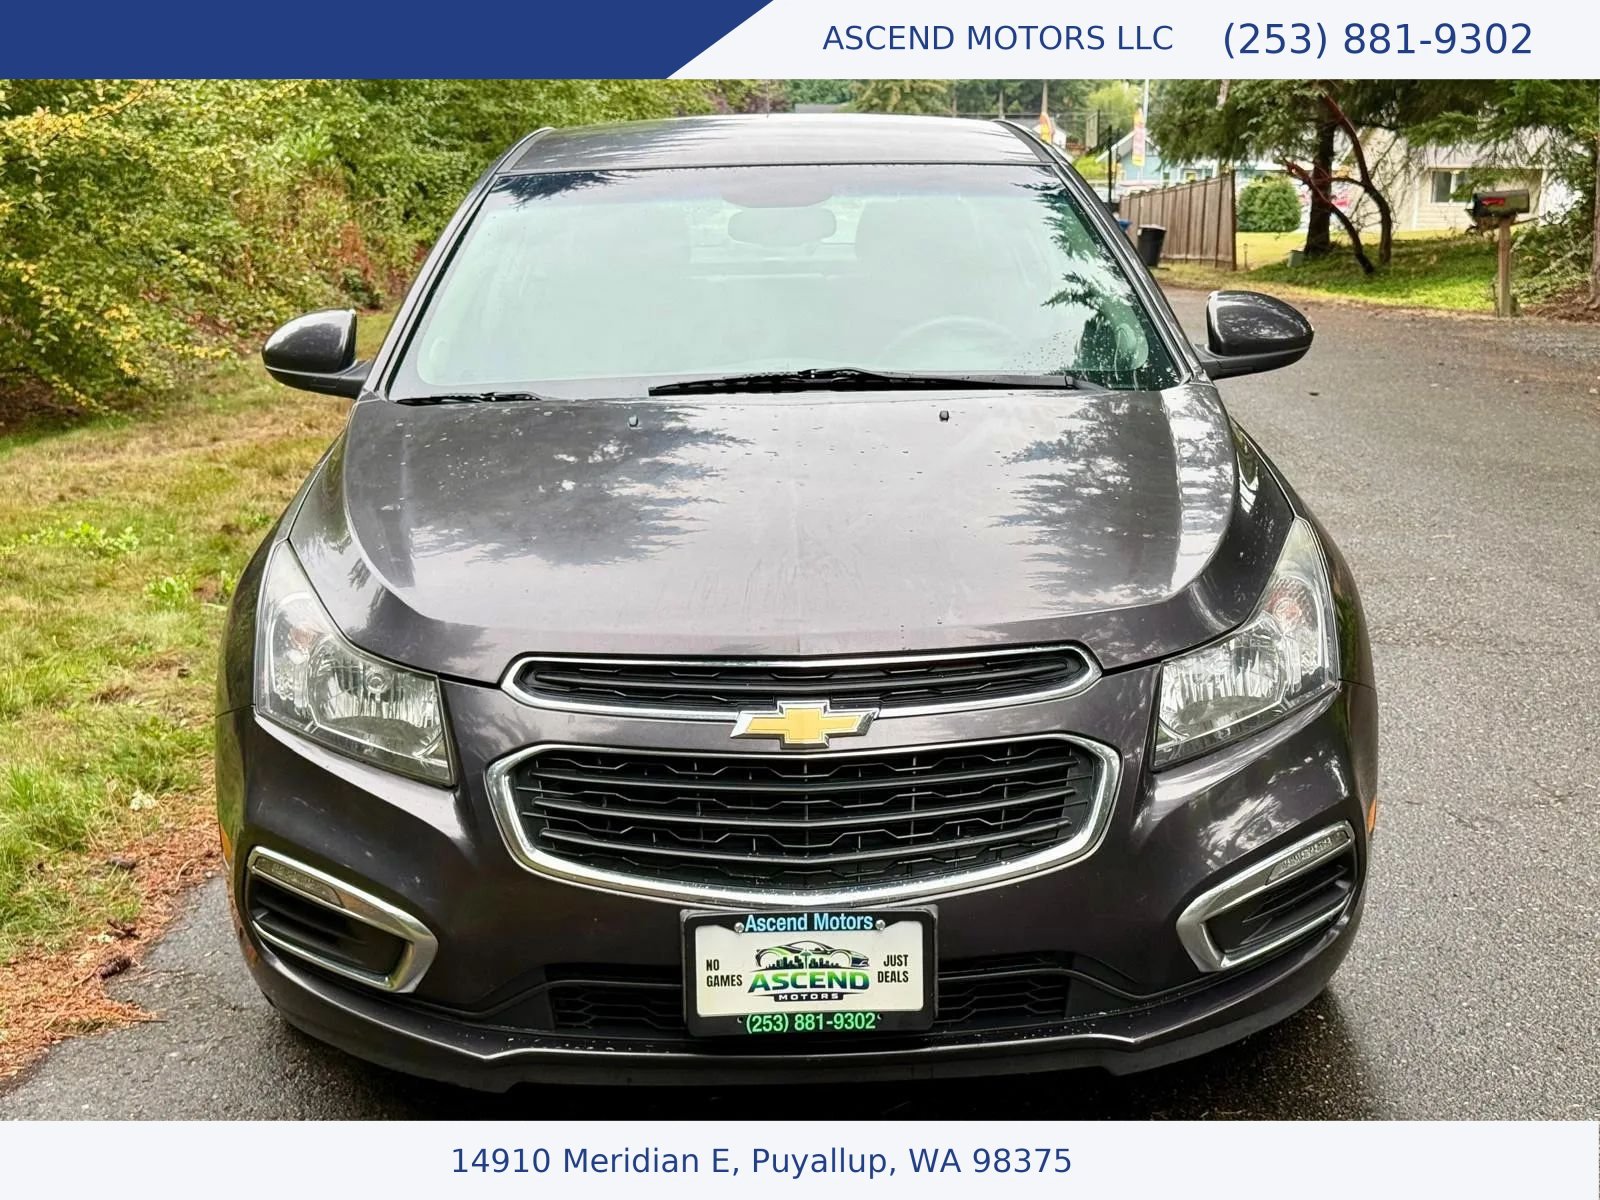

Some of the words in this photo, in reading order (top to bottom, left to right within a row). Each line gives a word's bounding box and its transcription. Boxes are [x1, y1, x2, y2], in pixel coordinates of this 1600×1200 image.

[744, 914, 808, 933] Ascend
[813, 913, 874, 931] Motors
[706, 959, 720, 972] NO
[883, 954, 909, 967] JUST
[706, 974, 743, 988] GAMES
[747, 971, 870, 993] ASCEND
[877, 970, 909, 984] DEALS
[778, 992, 840, 1001] MOTORS
[745, 1013, 789, 1034] (253)
[794, 1012, 876, 1031] 881-9302
